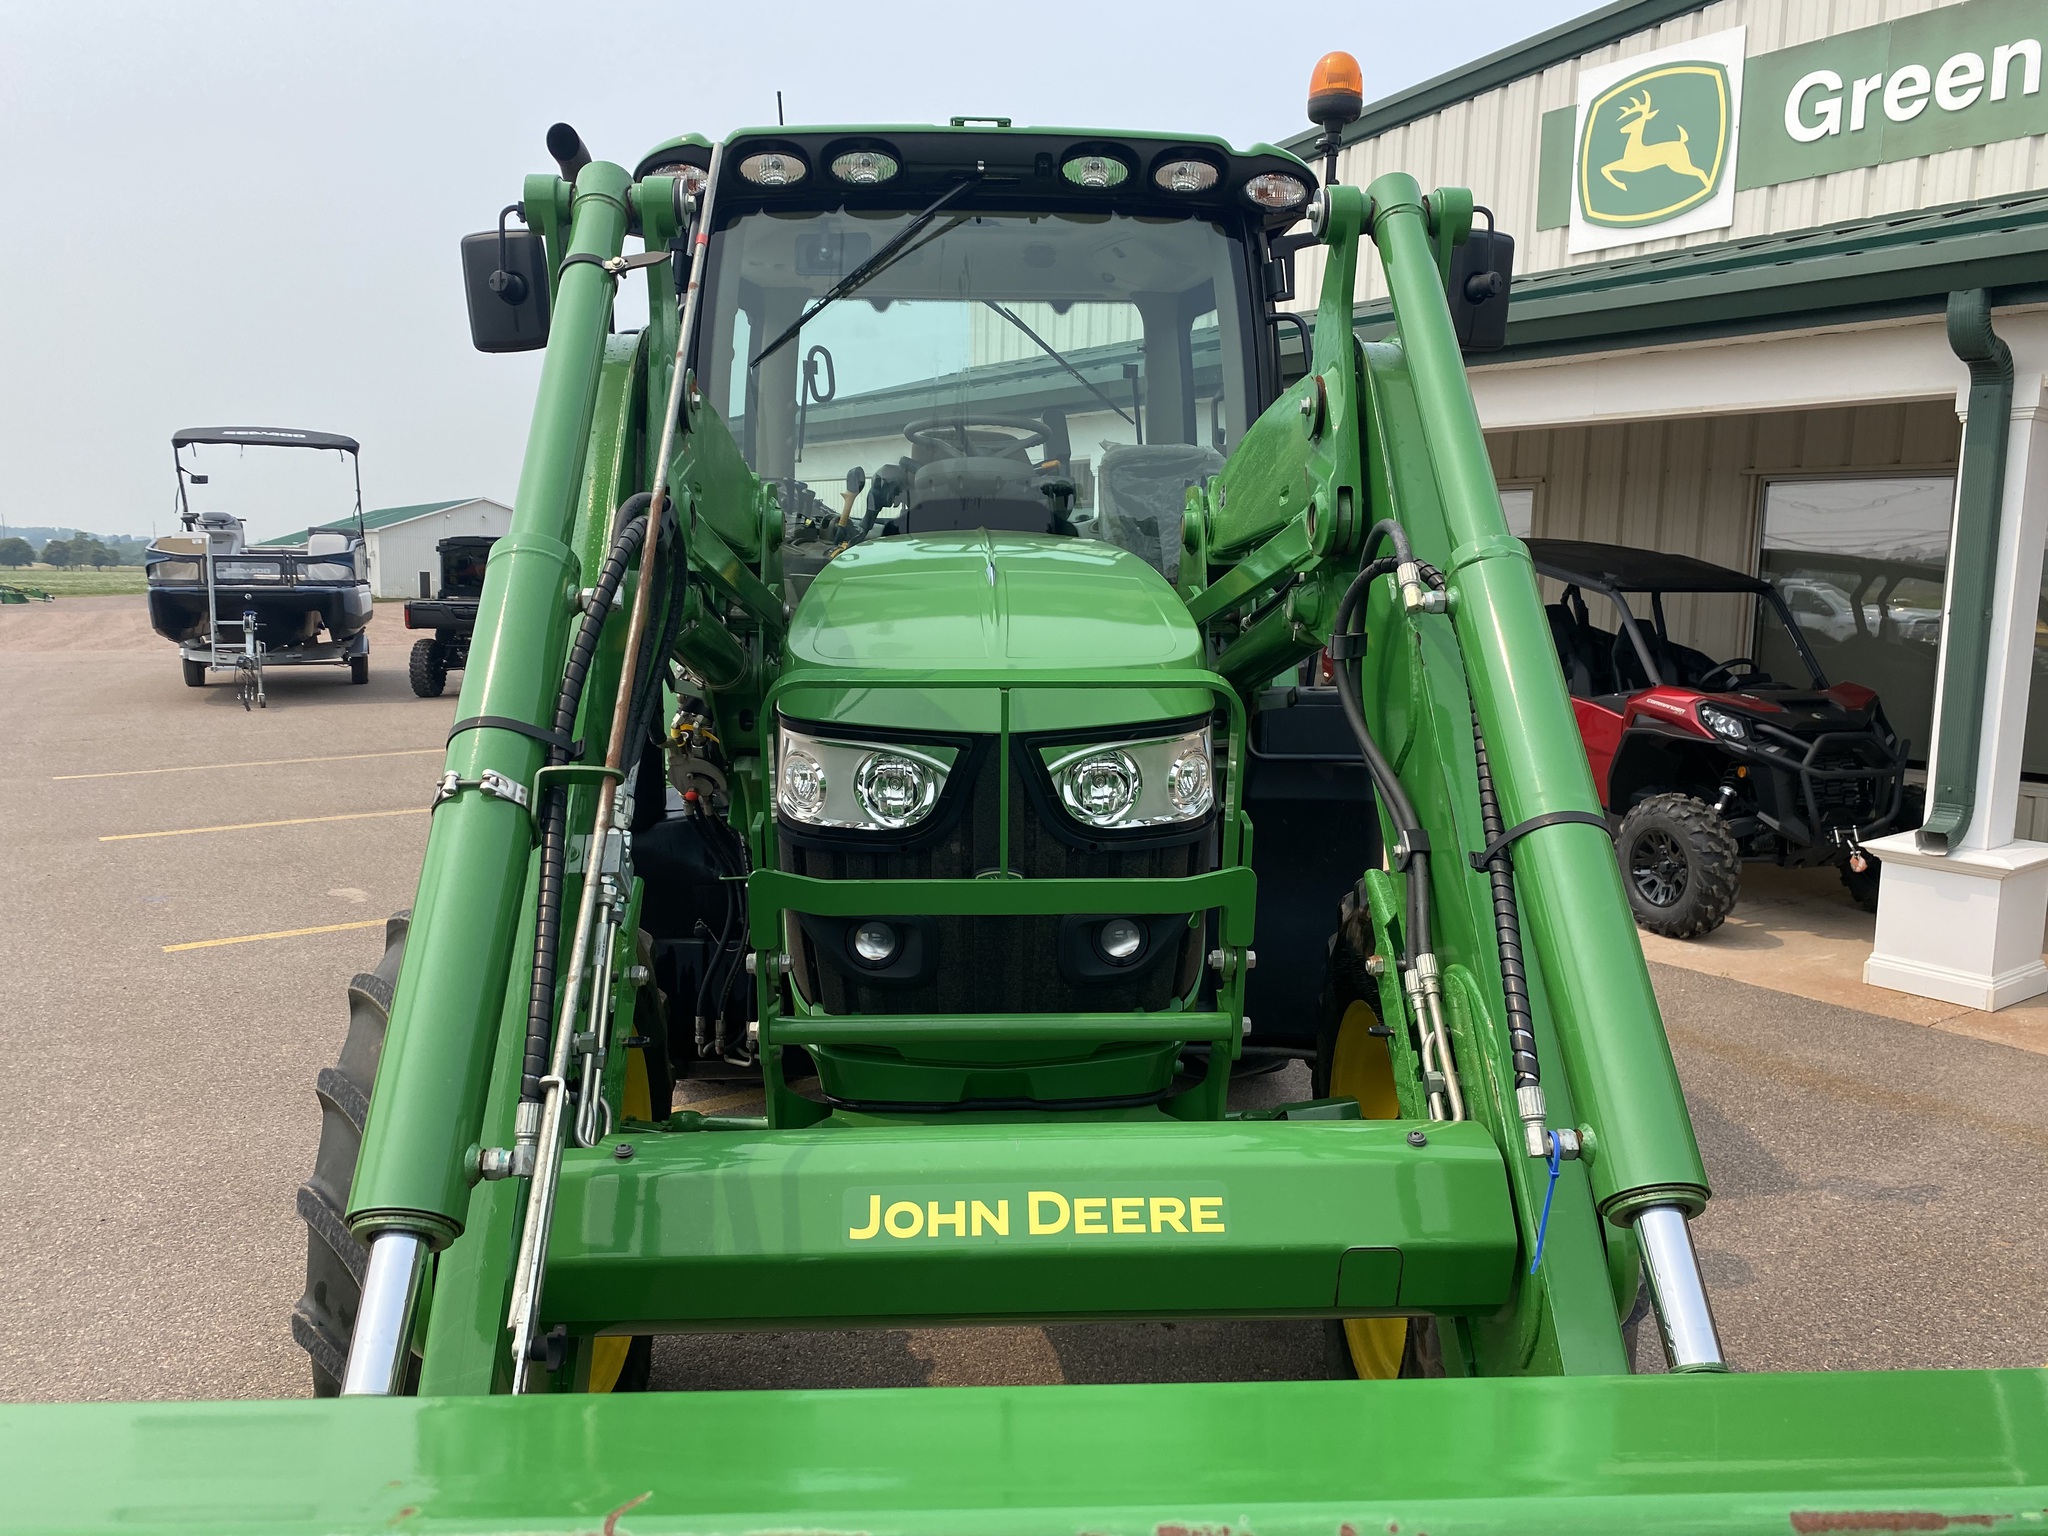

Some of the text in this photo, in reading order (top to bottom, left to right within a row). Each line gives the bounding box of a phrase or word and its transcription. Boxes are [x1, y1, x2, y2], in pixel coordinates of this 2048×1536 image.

[1784, 38, 2042, 143] Green
[849, 1190, 1226, 1240] JOHN DEERE
